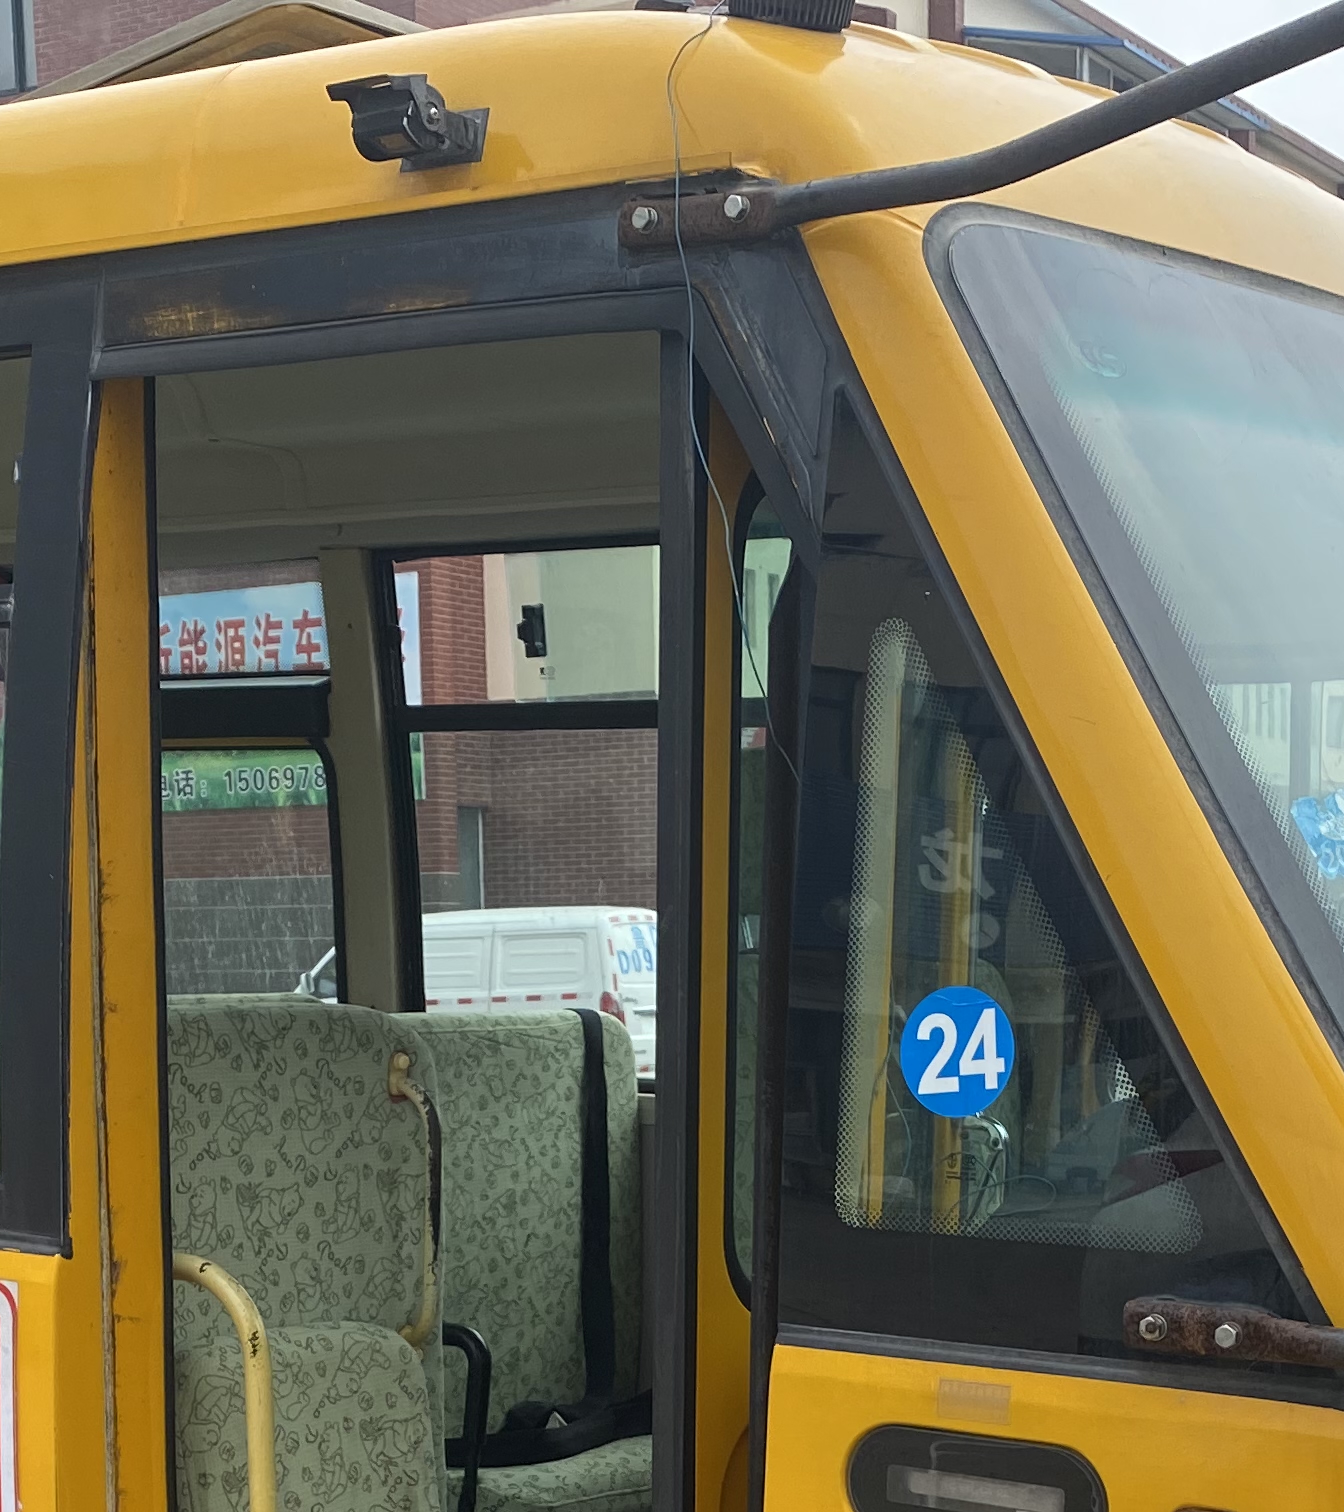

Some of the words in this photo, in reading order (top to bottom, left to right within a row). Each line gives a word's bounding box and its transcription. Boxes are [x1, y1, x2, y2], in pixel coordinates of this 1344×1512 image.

[917, 1008, 1005, 1095] 24
[316, 1058, 352, 1096] Pooh
[316, 1240, 351, 1275] Pooh
